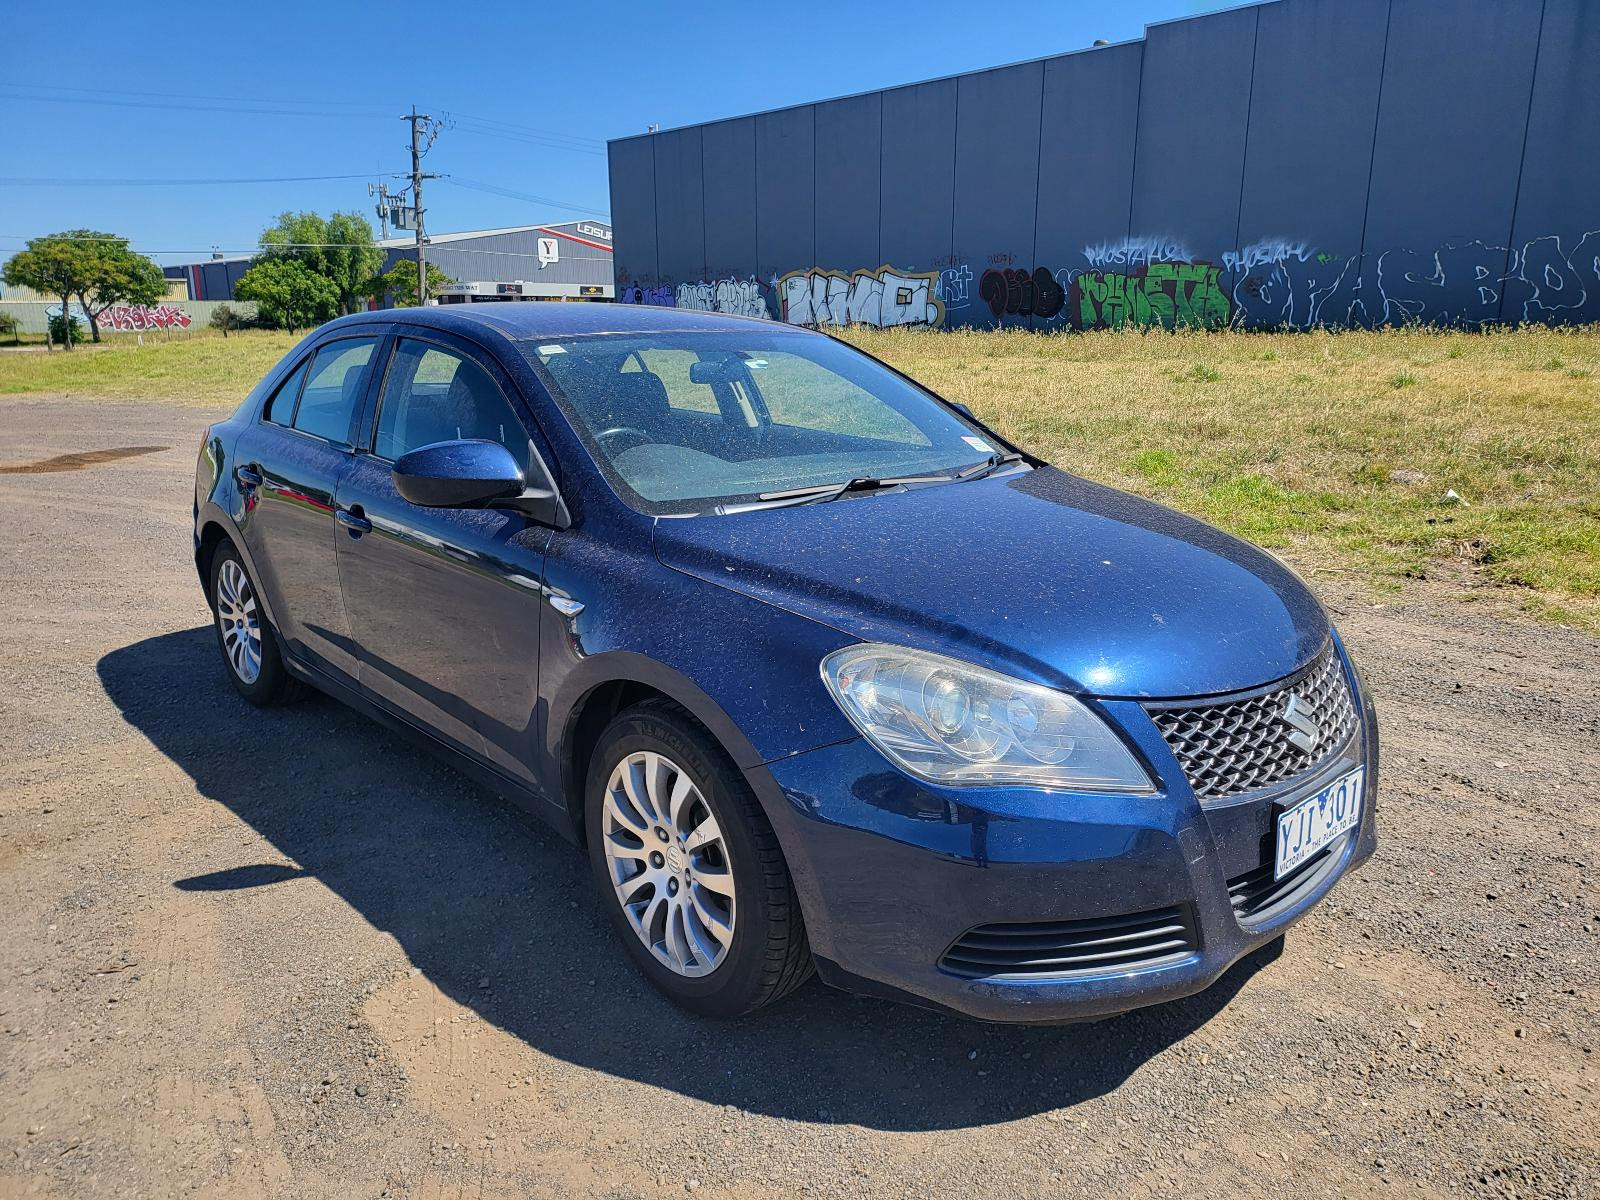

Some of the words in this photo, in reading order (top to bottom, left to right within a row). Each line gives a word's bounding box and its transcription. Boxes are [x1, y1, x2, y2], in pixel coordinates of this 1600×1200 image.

[1280, 850, 1305, 873] VICTORIA
[1312, 838, 1321, 848] THE
[1323, 826, 1338, 840] PLACE
[1282, 806, 1315, 862] YJI
[1326, 778, 1358, 829] 301
